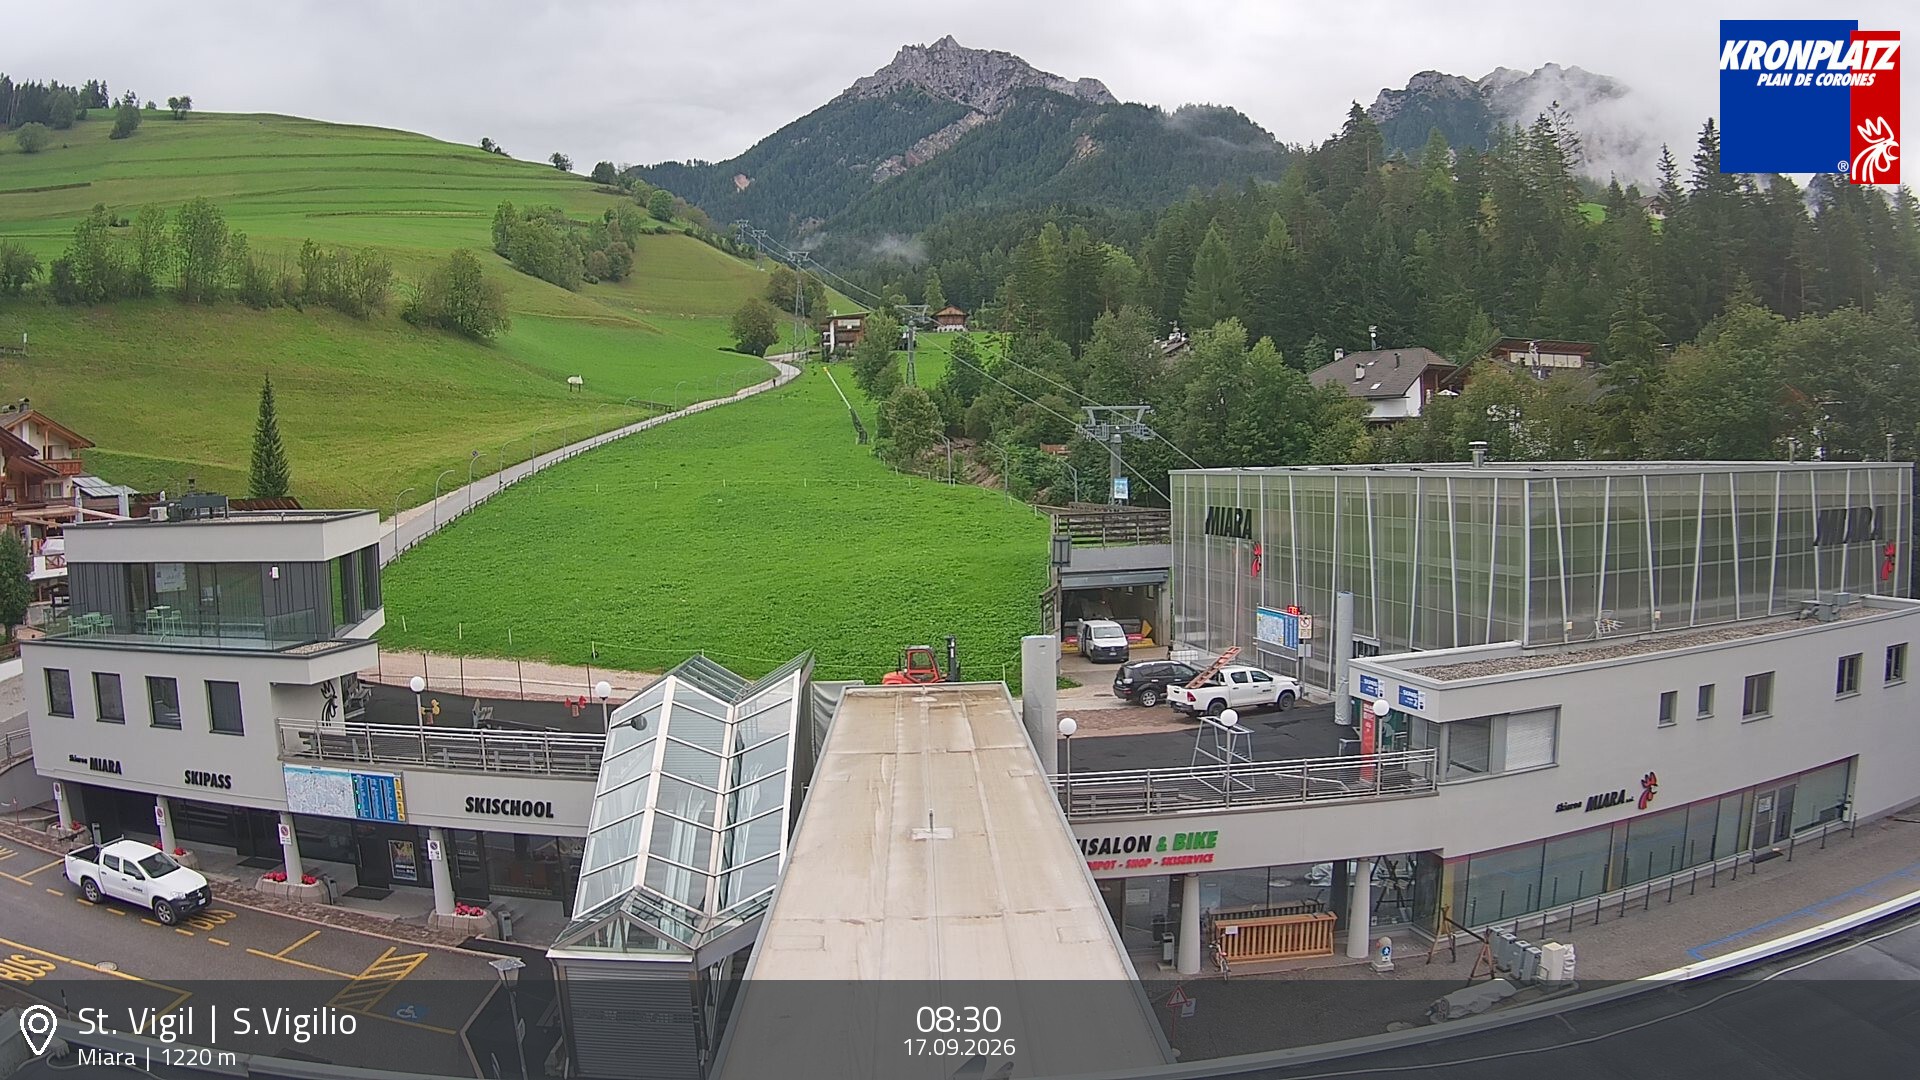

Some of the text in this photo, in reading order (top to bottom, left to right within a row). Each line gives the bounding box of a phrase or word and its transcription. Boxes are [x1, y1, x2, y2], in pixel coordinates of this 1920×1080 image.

[1205, 506, 1253, 540] MIARA
[90, 756, 122, 775] MIARA
[184, 769, 232, 789] SKIPASS
[465, 796, 554, 819] SKISCHOOL
[1585, 789, 1626, 813] MIARA
[1156, 836, 1168, 852] &
[1173, 831, 1218, 851] BIKE
[1125, 858, 1152, 869] SHOP
[1160, 853, 1215, 867] SKISERVICE
